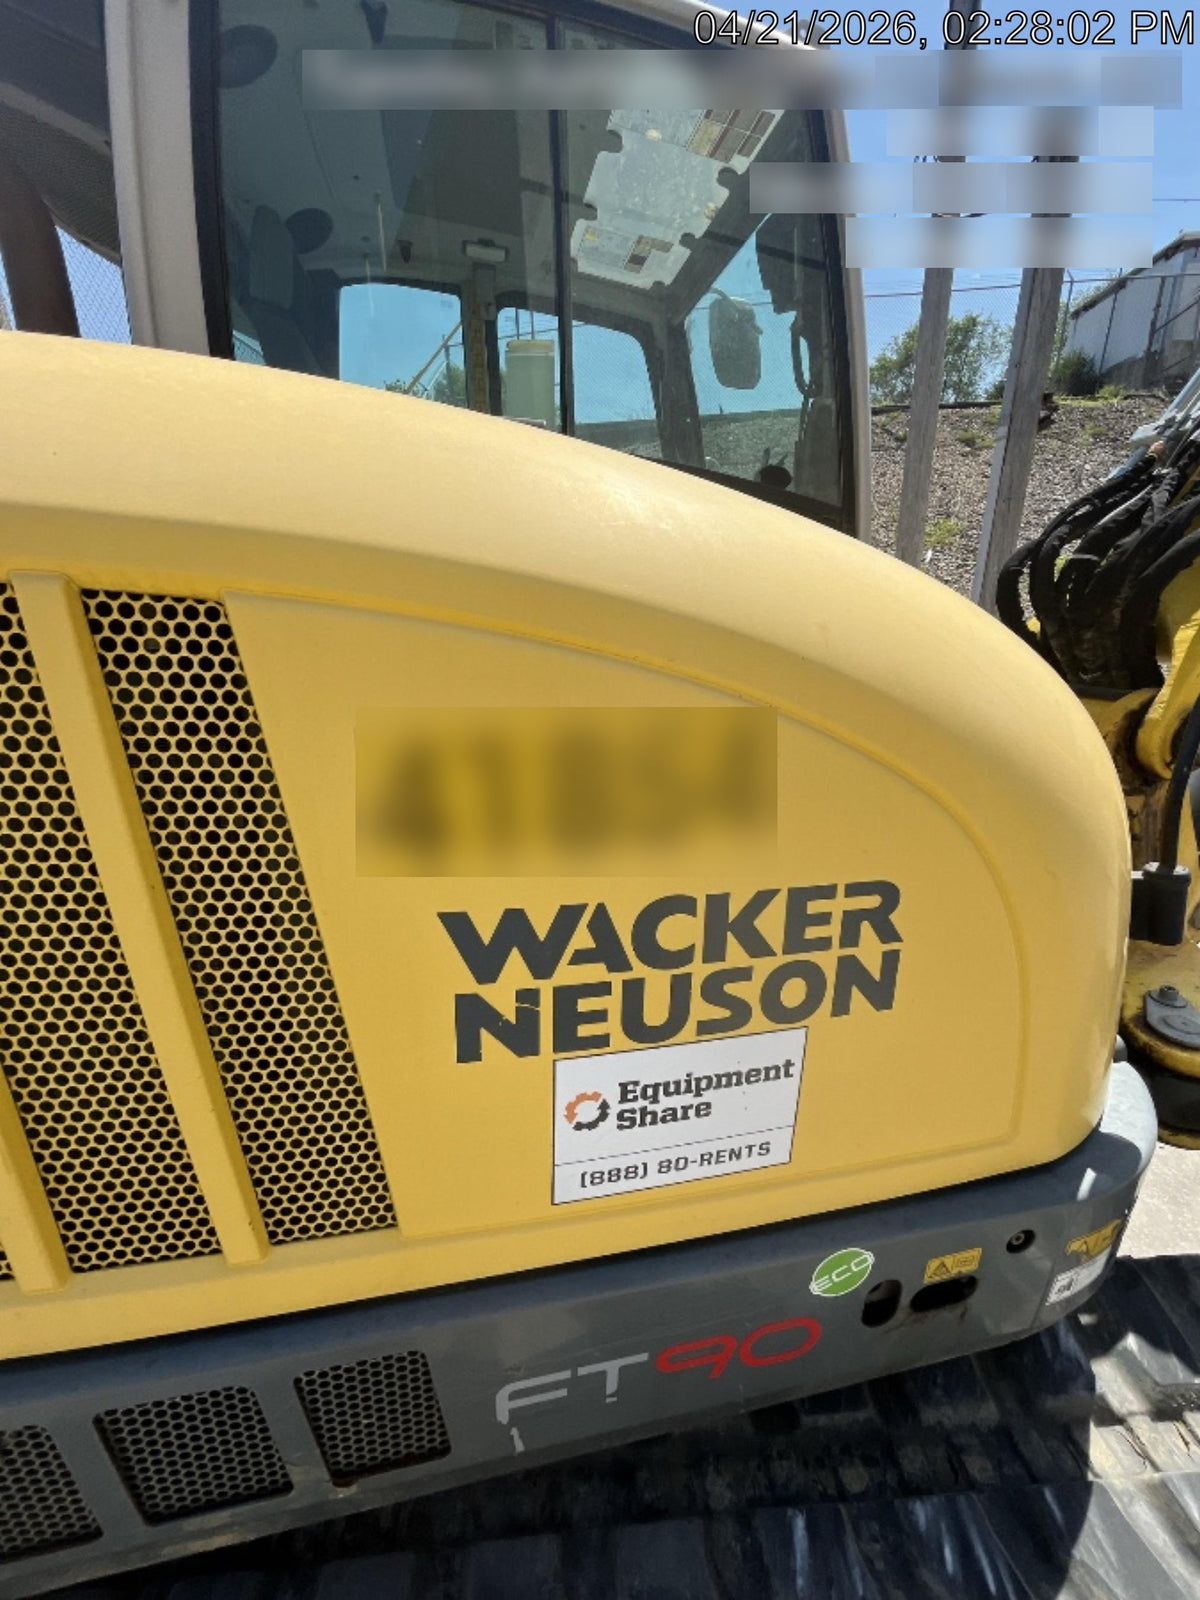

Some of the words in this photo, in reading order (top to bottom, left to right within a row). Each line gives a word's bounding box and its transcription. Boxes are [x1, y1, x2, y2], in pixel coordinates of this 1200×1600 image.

[436, 880, 904, 985] WACKER
[454, 948, 902, 1063] NEUSON
[617, 1057, 796, 1104] Equipment
[616, 1101, 713, 1131] Share
[580, 1162, 649, 1188] (888)
[657, 1141, 772, 1175] 80-RENTS
[809, 1251, 875, 1295] ECO
